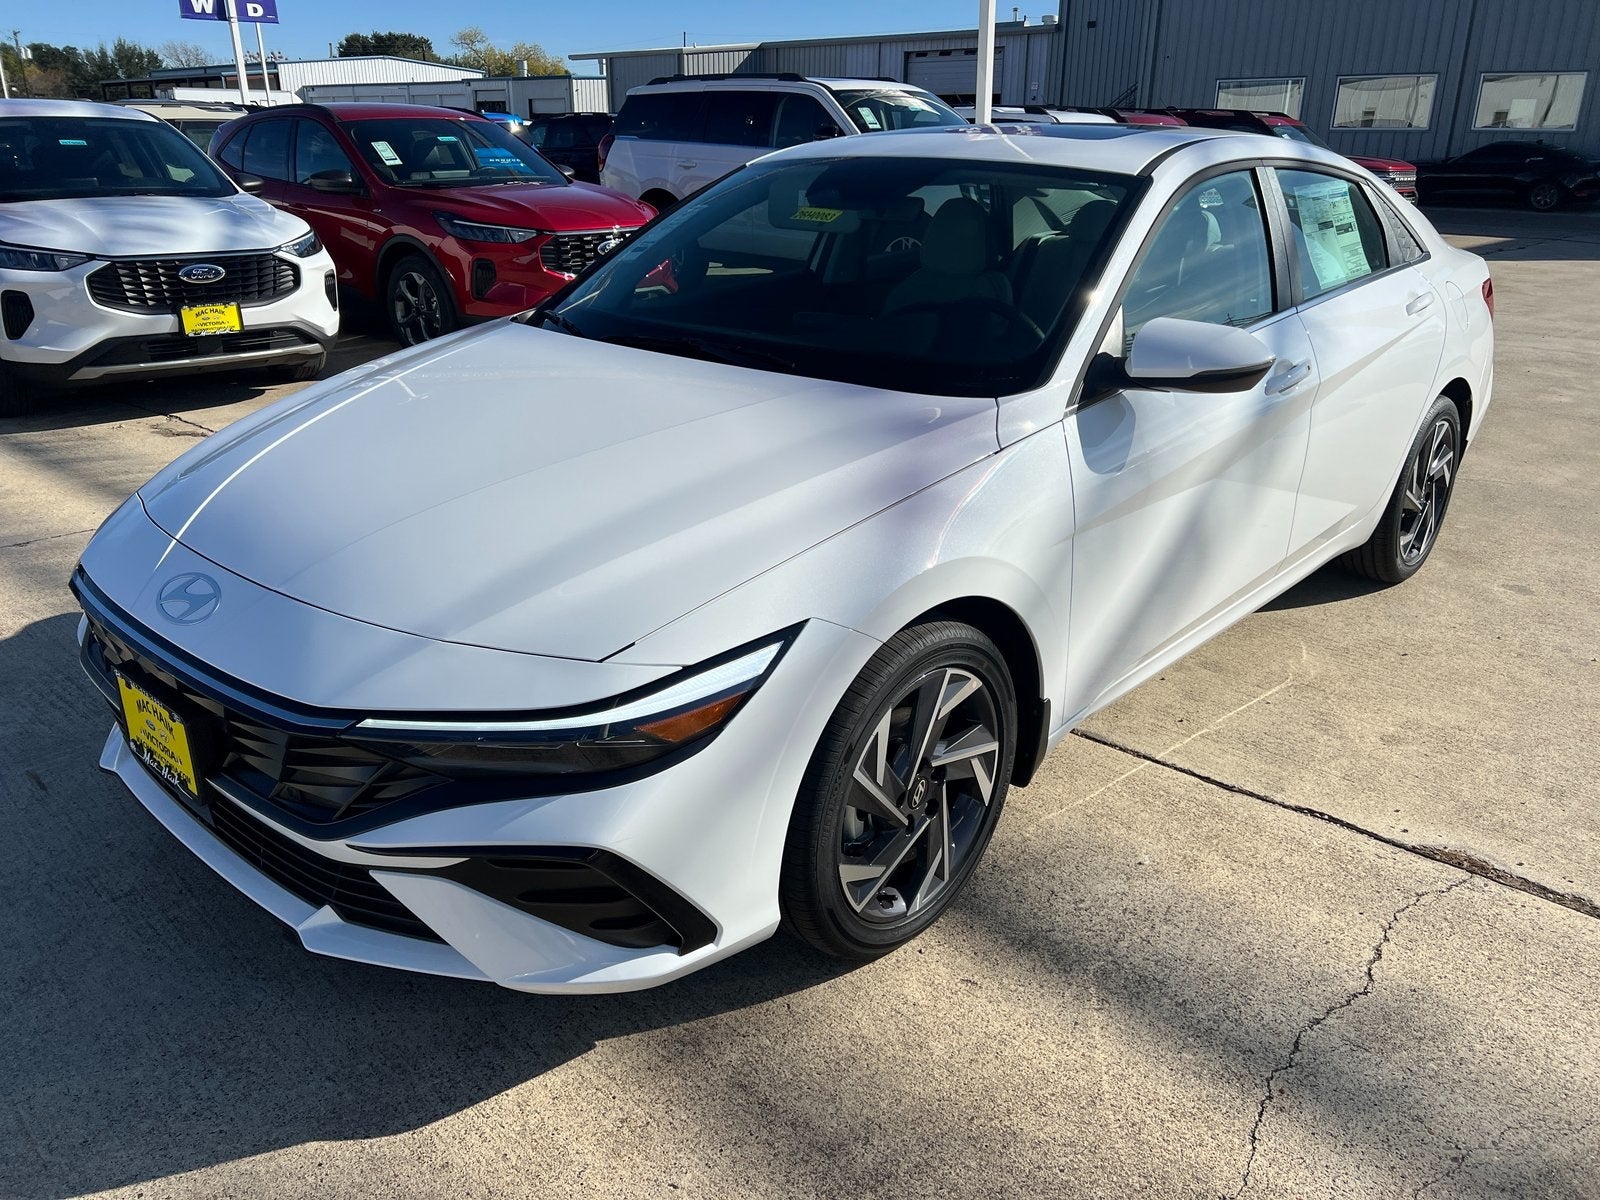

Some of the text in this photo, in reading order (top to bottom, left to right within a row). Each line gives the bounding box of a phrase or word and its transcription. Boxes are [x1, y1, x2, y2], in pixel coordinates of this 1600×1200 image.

[191, 0, 214, 14] W
[246, 3, 264, 17] D
[191, 268, 216, 279] Ford
[195, 308, 209, 319] MAC
[136, 699, 152, 714] MAC
[152, 704, 176, 742] HAIK
